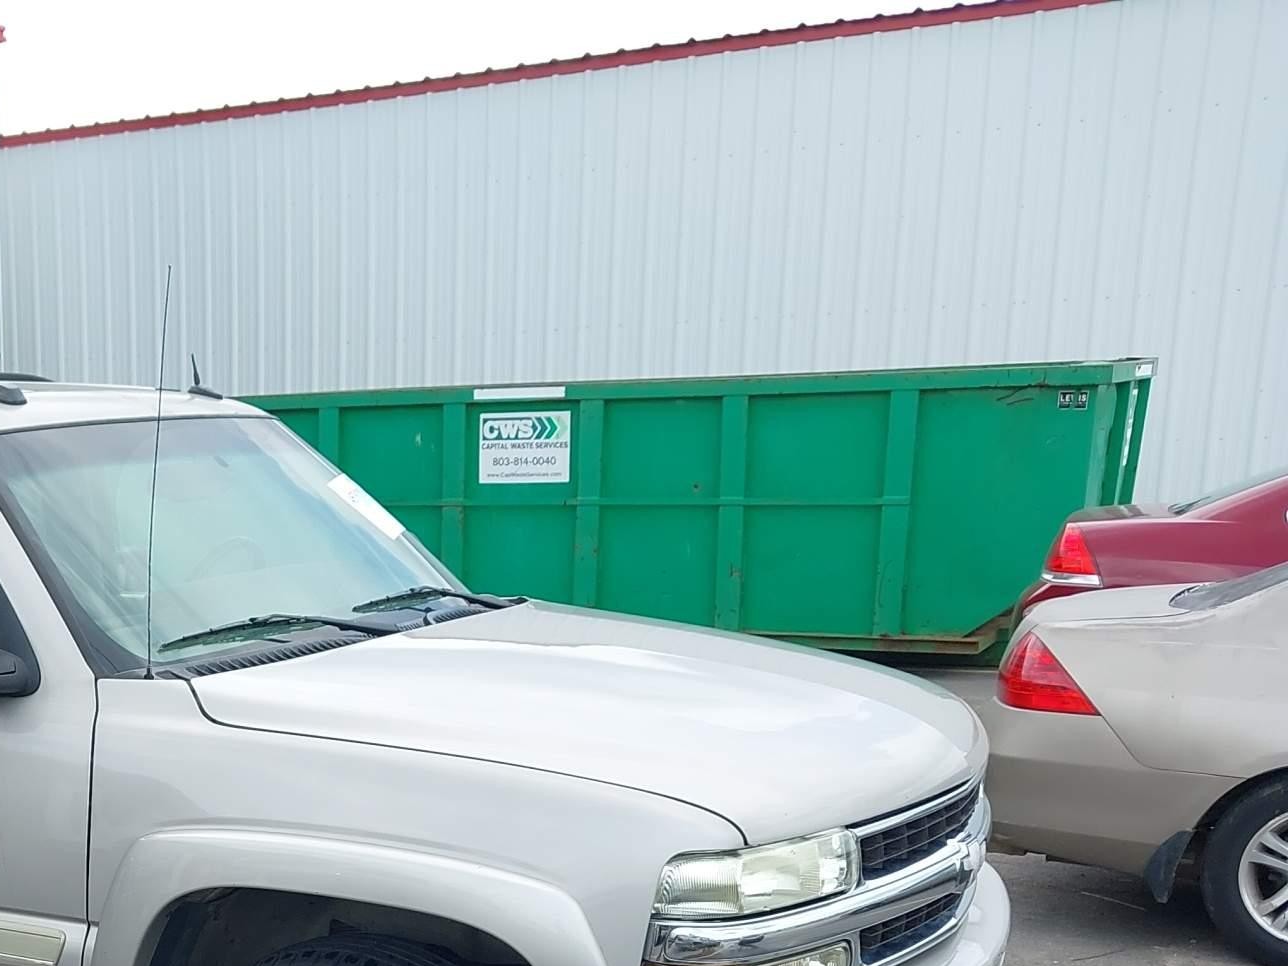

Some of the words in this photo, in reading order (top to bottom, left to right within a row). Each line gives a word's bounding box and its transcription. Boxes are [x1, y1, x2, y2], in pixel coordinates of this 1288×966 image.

[483, 419, 534, 440] CWS
[481, 442, 508, 450] CAPITAL
[510, 441, 534, 449] WASTE
[535, 441, 568, 449] SERVICES
[492, 456, 557, 467] 803-814-0040
